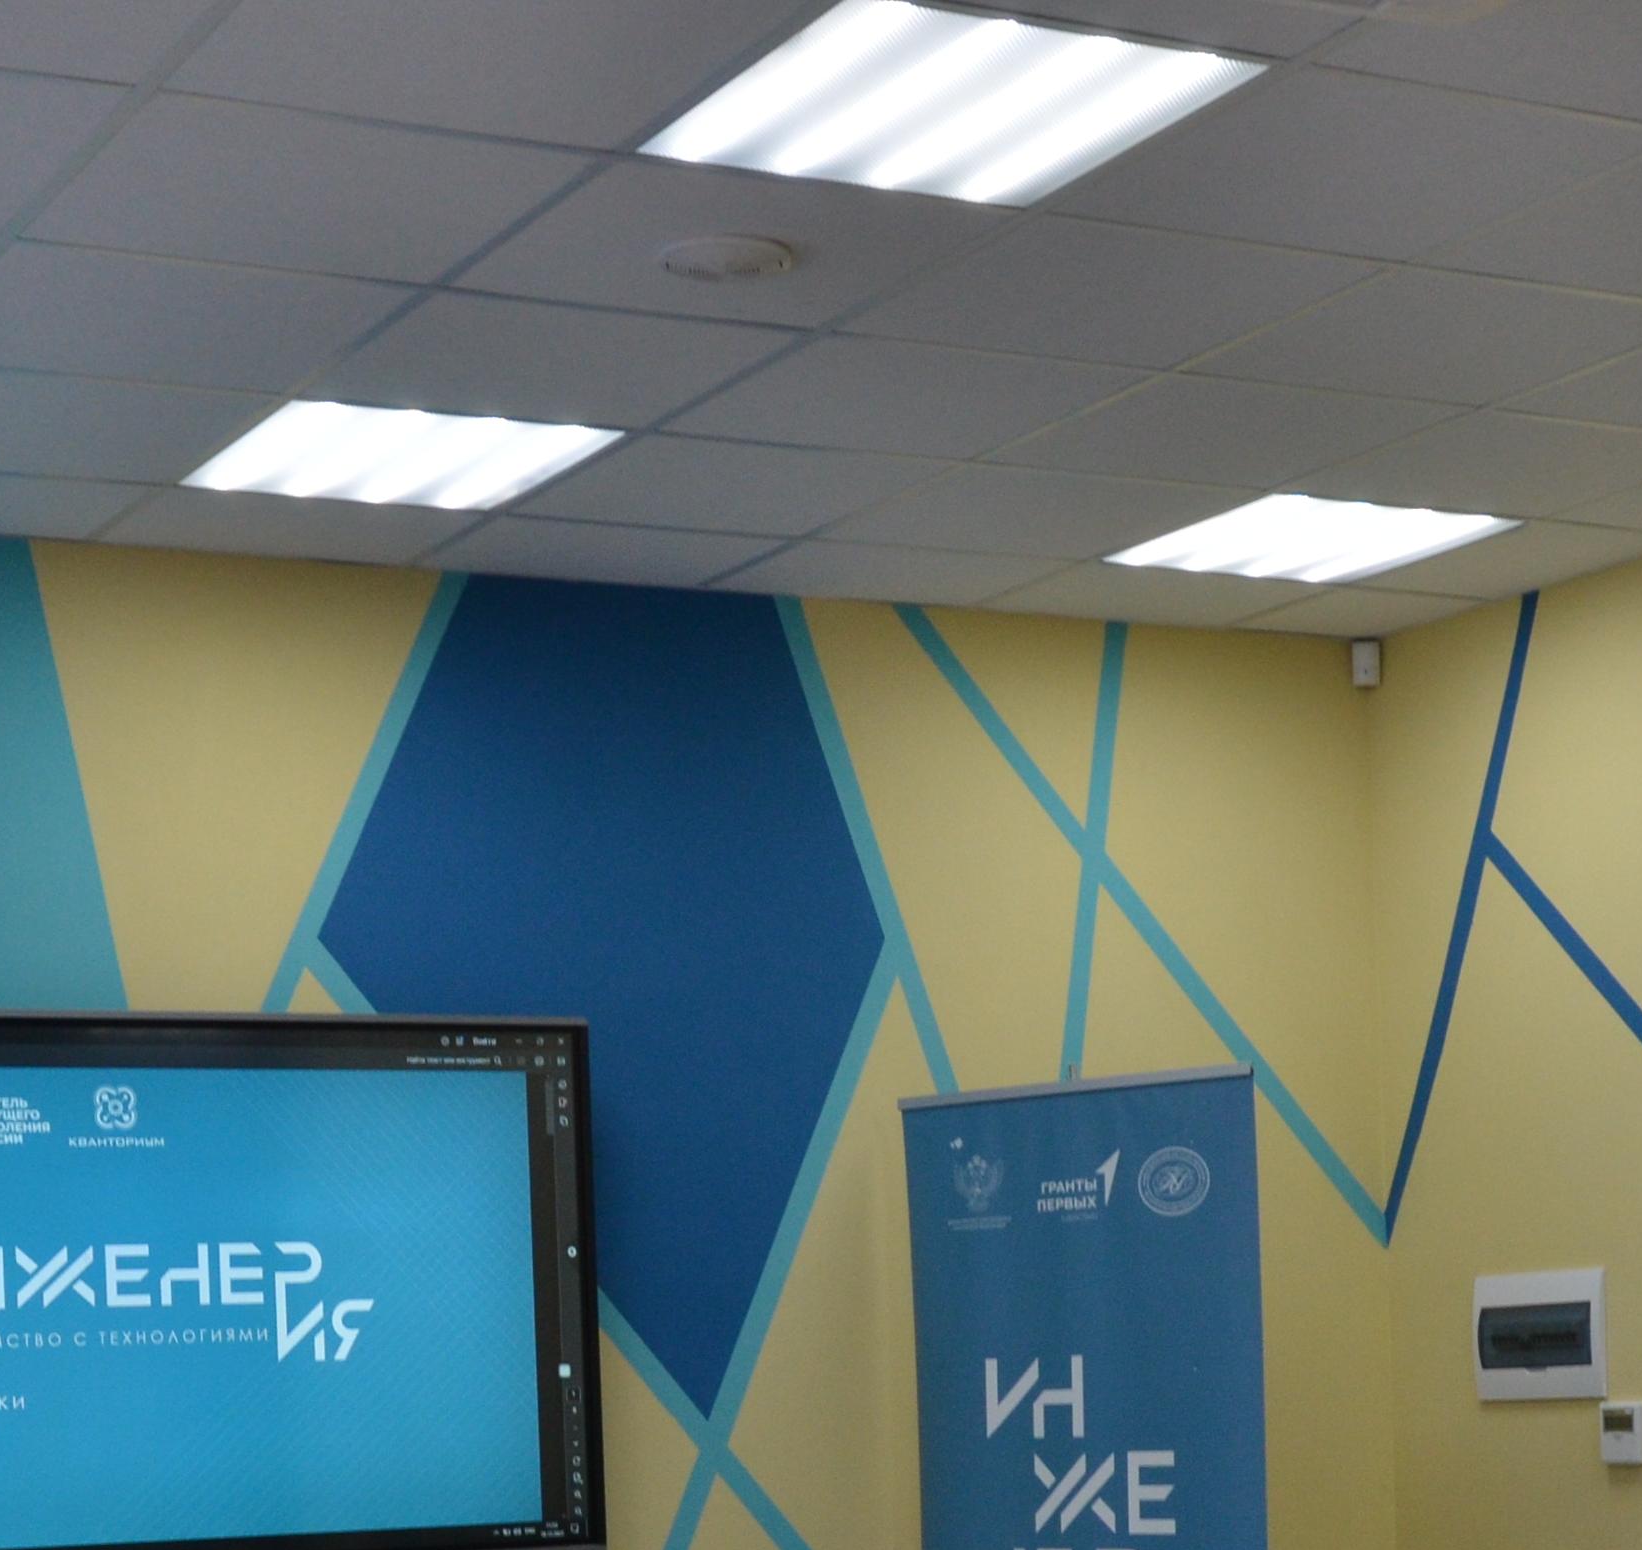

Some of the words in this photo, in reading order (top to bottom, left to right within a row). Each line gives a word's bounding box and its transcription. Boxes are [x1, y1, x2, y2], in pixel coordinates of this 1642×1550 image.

[68, 1136, 165, 1149] КВАНТОРИУМ
[1040, 1178, 1098, 1195] ГРАНТЫ
[1036, 1195, 1098, 1214] ПЕРВЫХ
[73, 1331, 87, 1347] С
[98, 1326, 270, 1347] ТЕХНОЛОГИЯМИ
